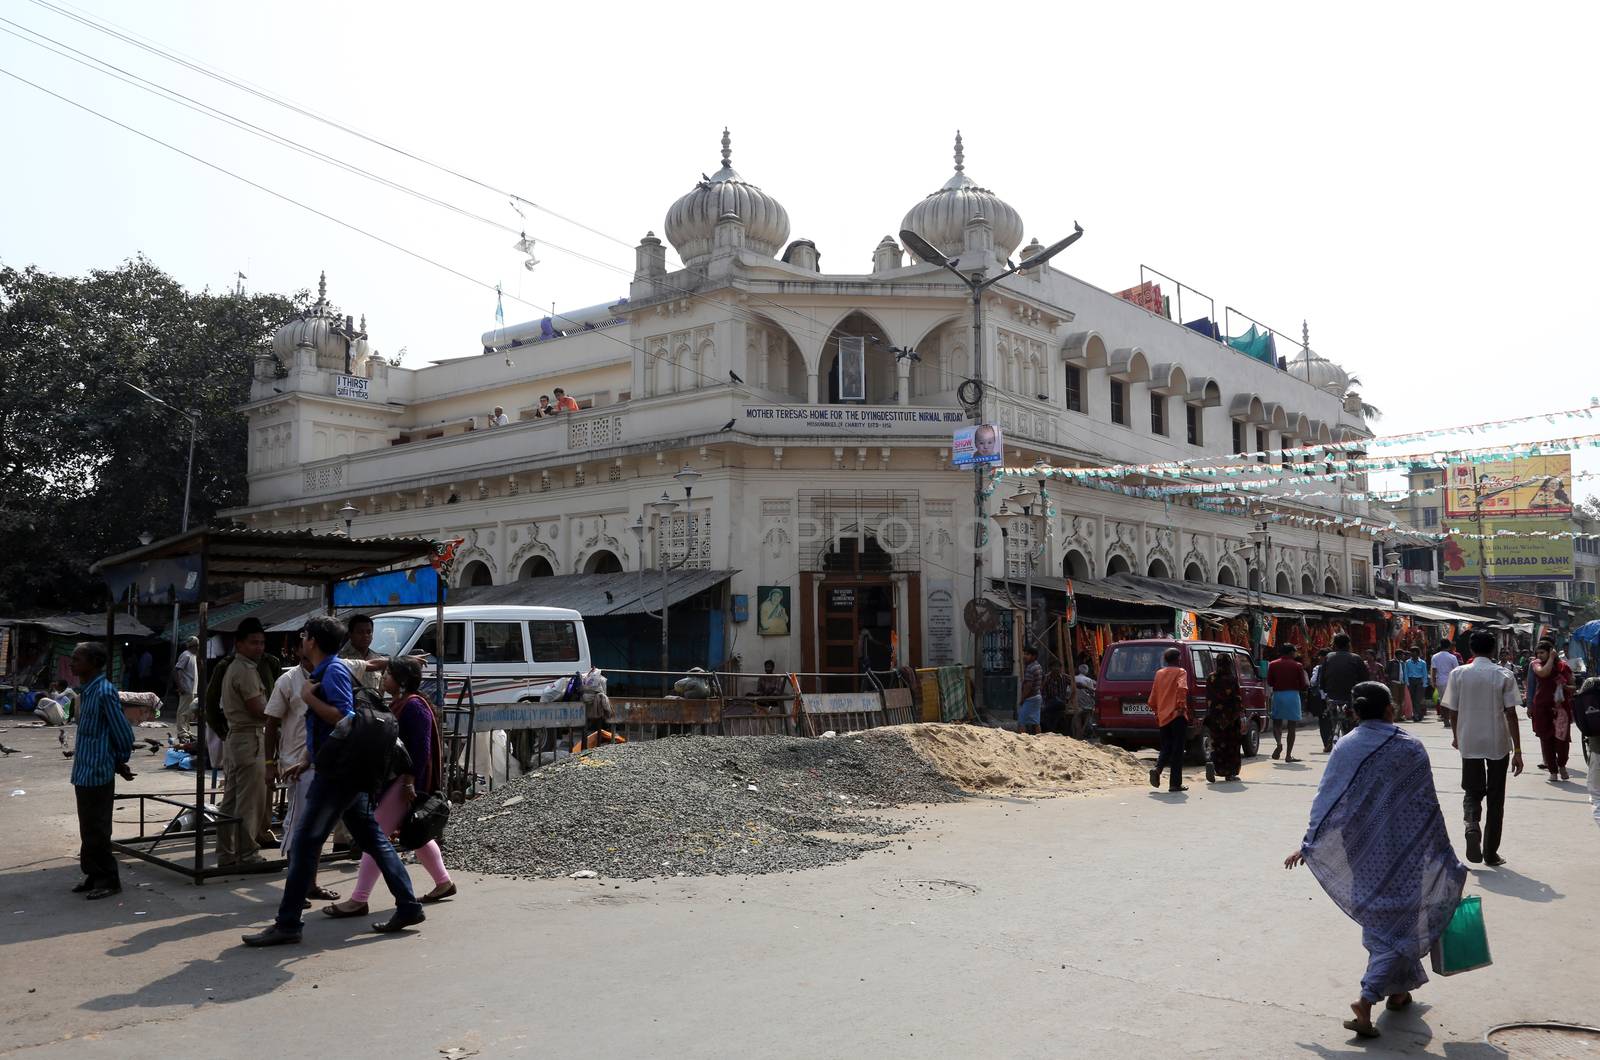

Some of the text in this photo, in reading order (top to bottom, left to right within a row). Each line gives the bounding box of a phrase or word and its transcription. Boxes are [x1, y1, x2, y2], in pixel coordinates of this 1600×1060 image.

[342, 377, 368, 390] THIRST
[746, 408, 774, 419] MOTHER
[809, 410, 829, 420] HOME
[830, 410, 843, 420] FOR
[845, 410, 860, 421] THE
[918, 411, 942, 423] NIRMAL
[943, 412, 964, 423] HRIDAY
[954, 440, 972, 448] SHOW
[1541, 556, 1569, 565] BANK
